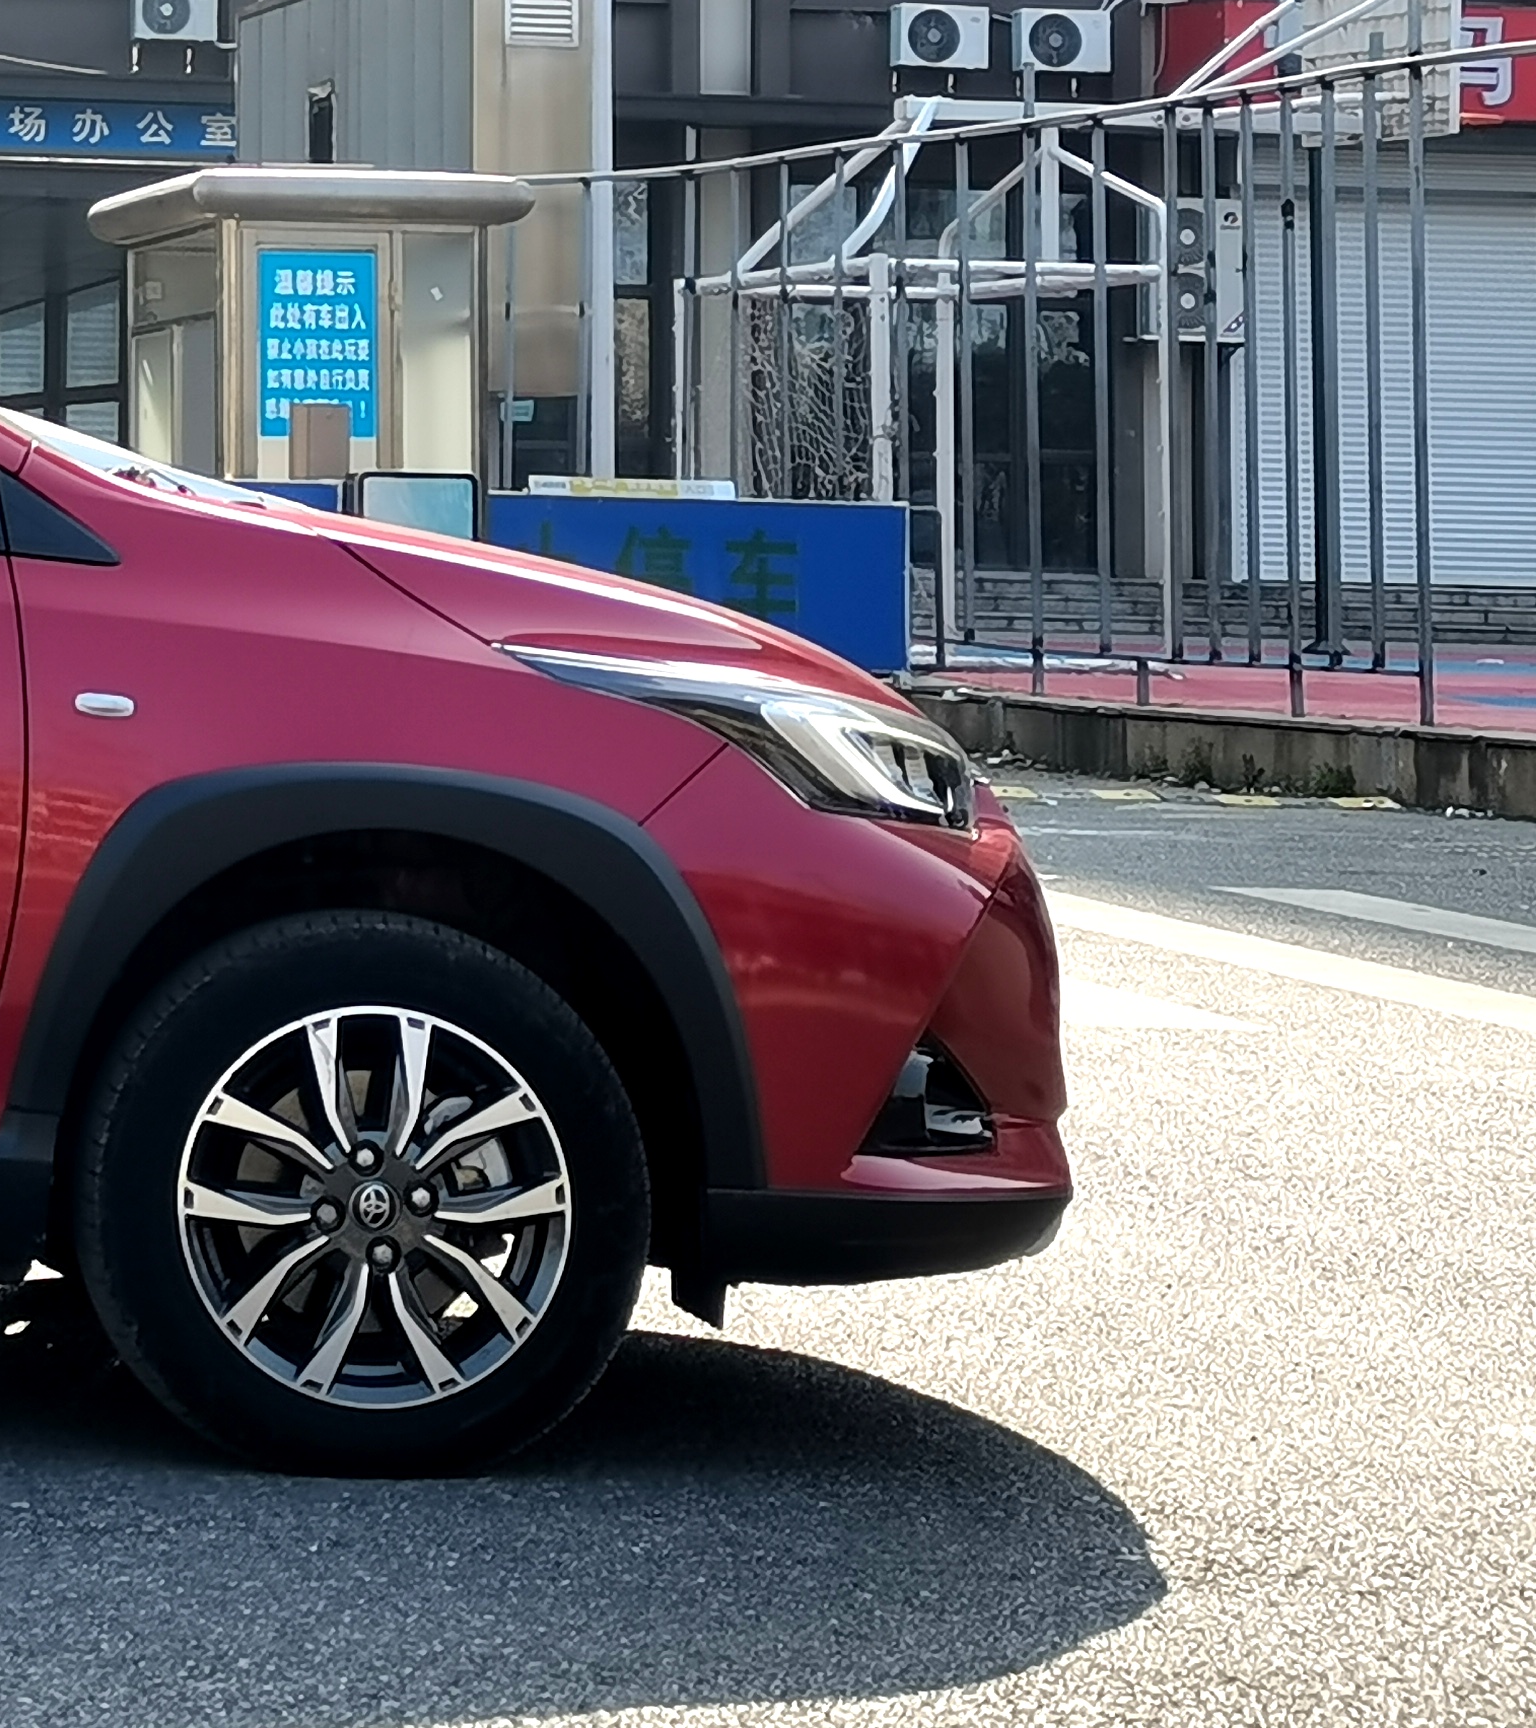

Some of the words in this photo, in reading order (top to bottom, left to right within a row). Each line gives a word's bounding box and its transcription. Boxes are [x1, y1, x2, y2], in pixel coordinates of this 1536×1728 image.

[274, 269, 356, 296] 温馨提示
[269, 302, 367, 330] 此处有车出入
